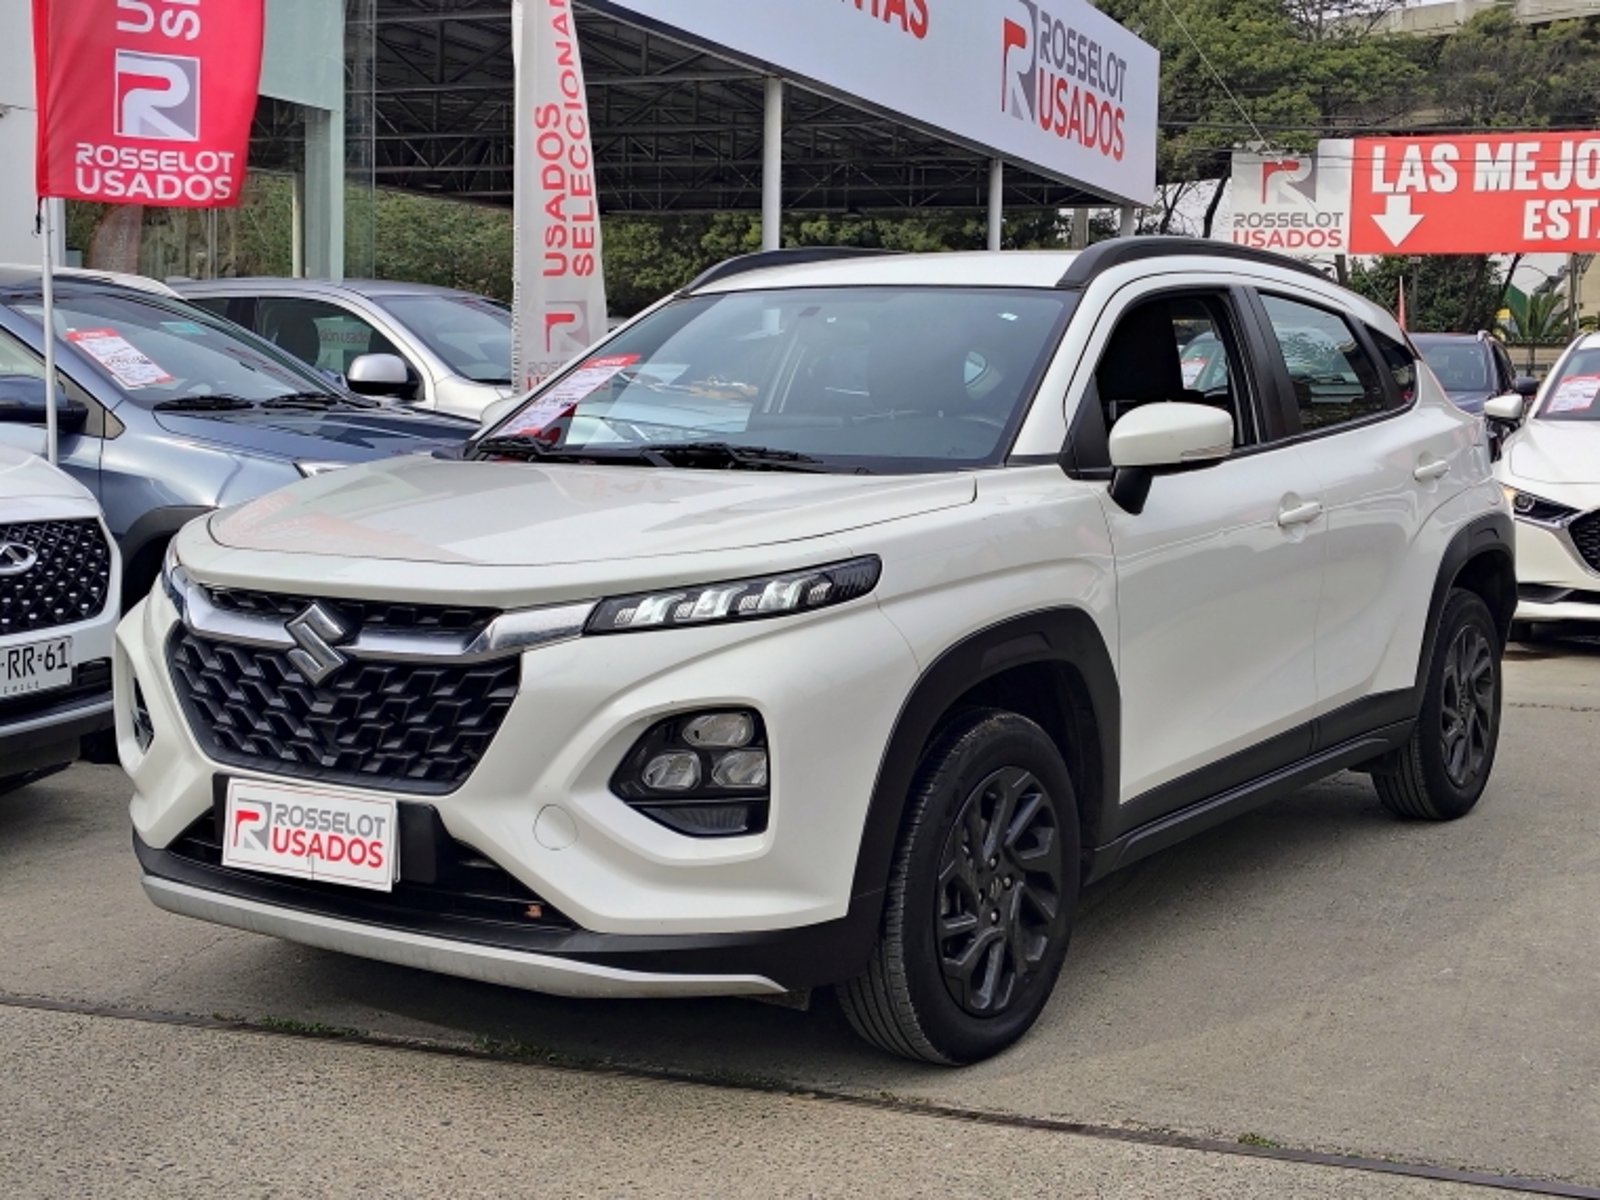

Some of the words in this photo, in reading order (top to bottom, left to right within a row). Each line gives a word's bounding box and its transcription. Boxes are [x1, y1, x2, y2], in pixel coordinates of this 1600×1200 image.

[160, 0, 200, 40] S
[1040, 10, 1127, 103] ROSSELOT
[1039, 67, 1126, 162] USADOS
[76, 143, 234, 173] ROSSELOT
[1371, 143, 1460, 193] LAS
[76, 167, 232, 201] USADOS
[535, 103, 568, 277] USADOS
[1232, 229, 1343, 248] USADOS
[1233, 211, 1344, 228] ROSSELOT
[1523, 198, 1600, 241] EST
[274, 803, 386, 839] ROSSELOT
[272, 827, 384, 868] USADOS
